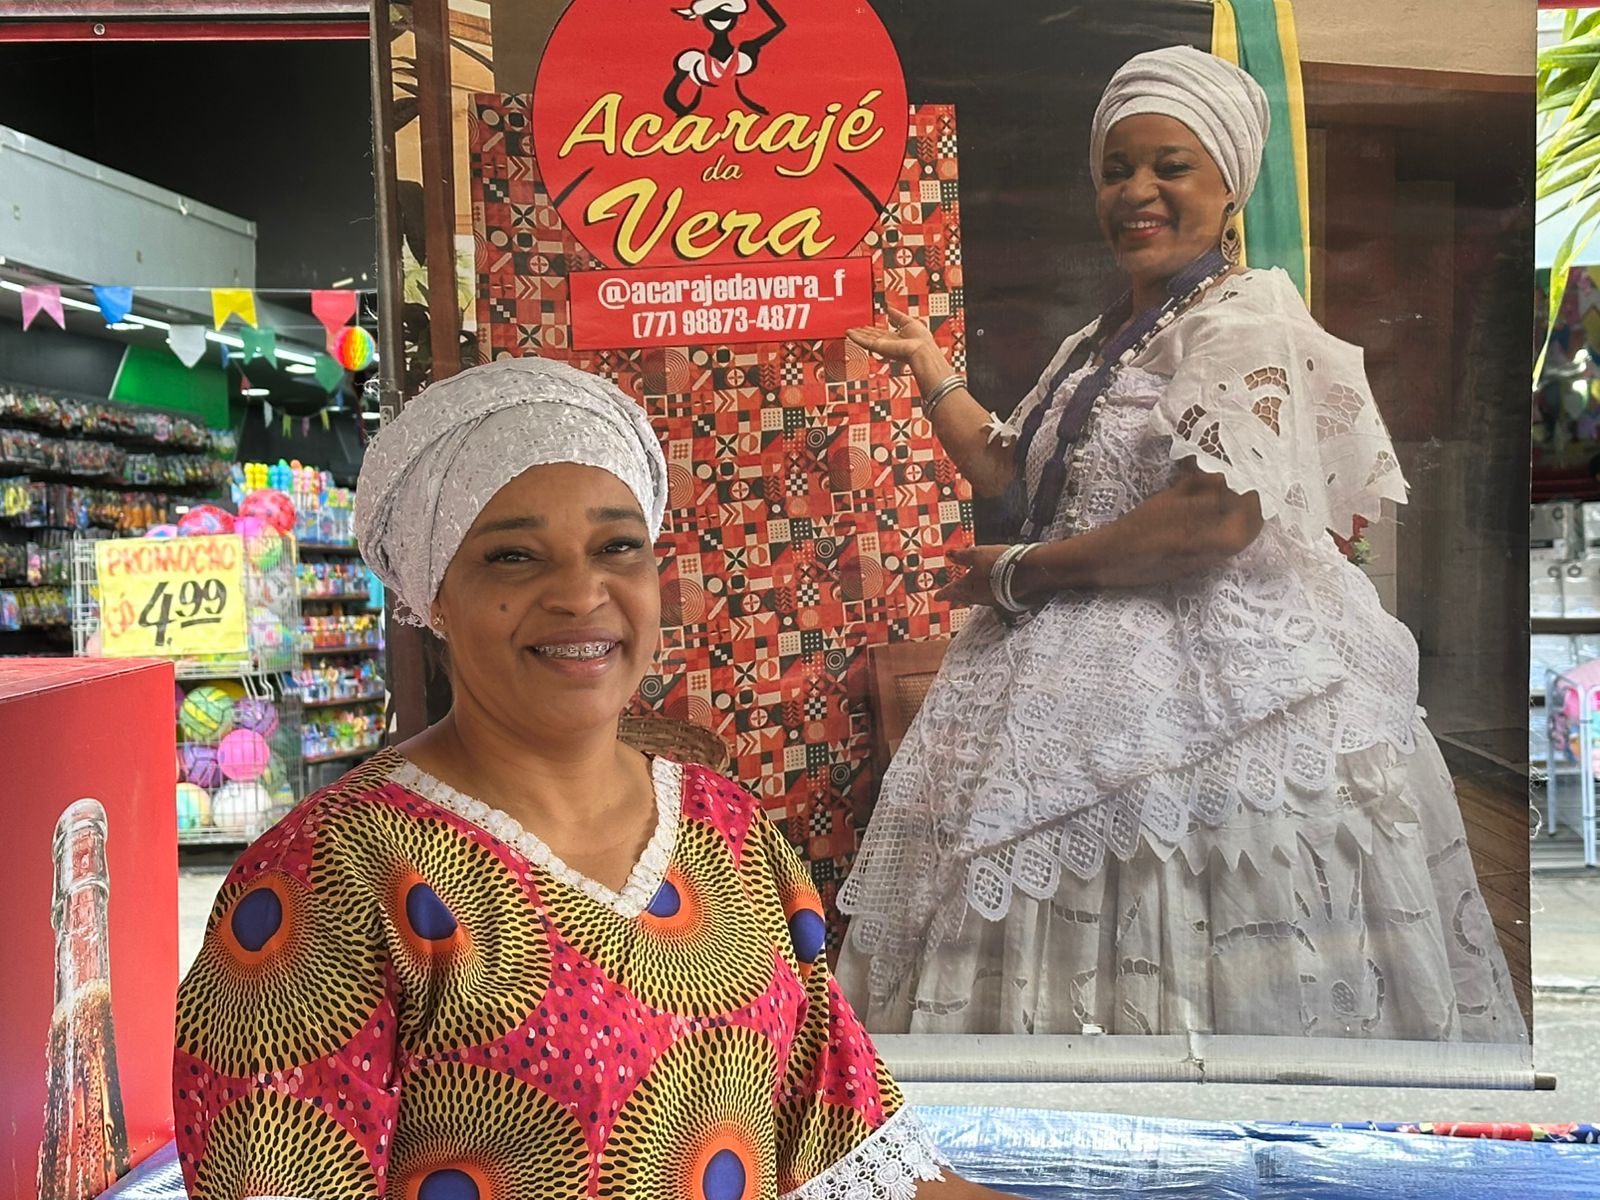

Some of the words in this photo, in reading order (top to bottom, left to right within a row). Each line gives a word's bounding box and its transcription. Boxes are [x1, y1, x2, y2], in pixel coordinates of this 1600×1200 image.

[558, 90, 884, 177] Acarajé
[702, 154, 743, 182] da
[585, 178, 836, 265] Vera
[597, 268, 846, 310] @acarajedavera_f
[632, 310, 677, 339] (77)
[682, 303, 811, 336] 98873-4877
